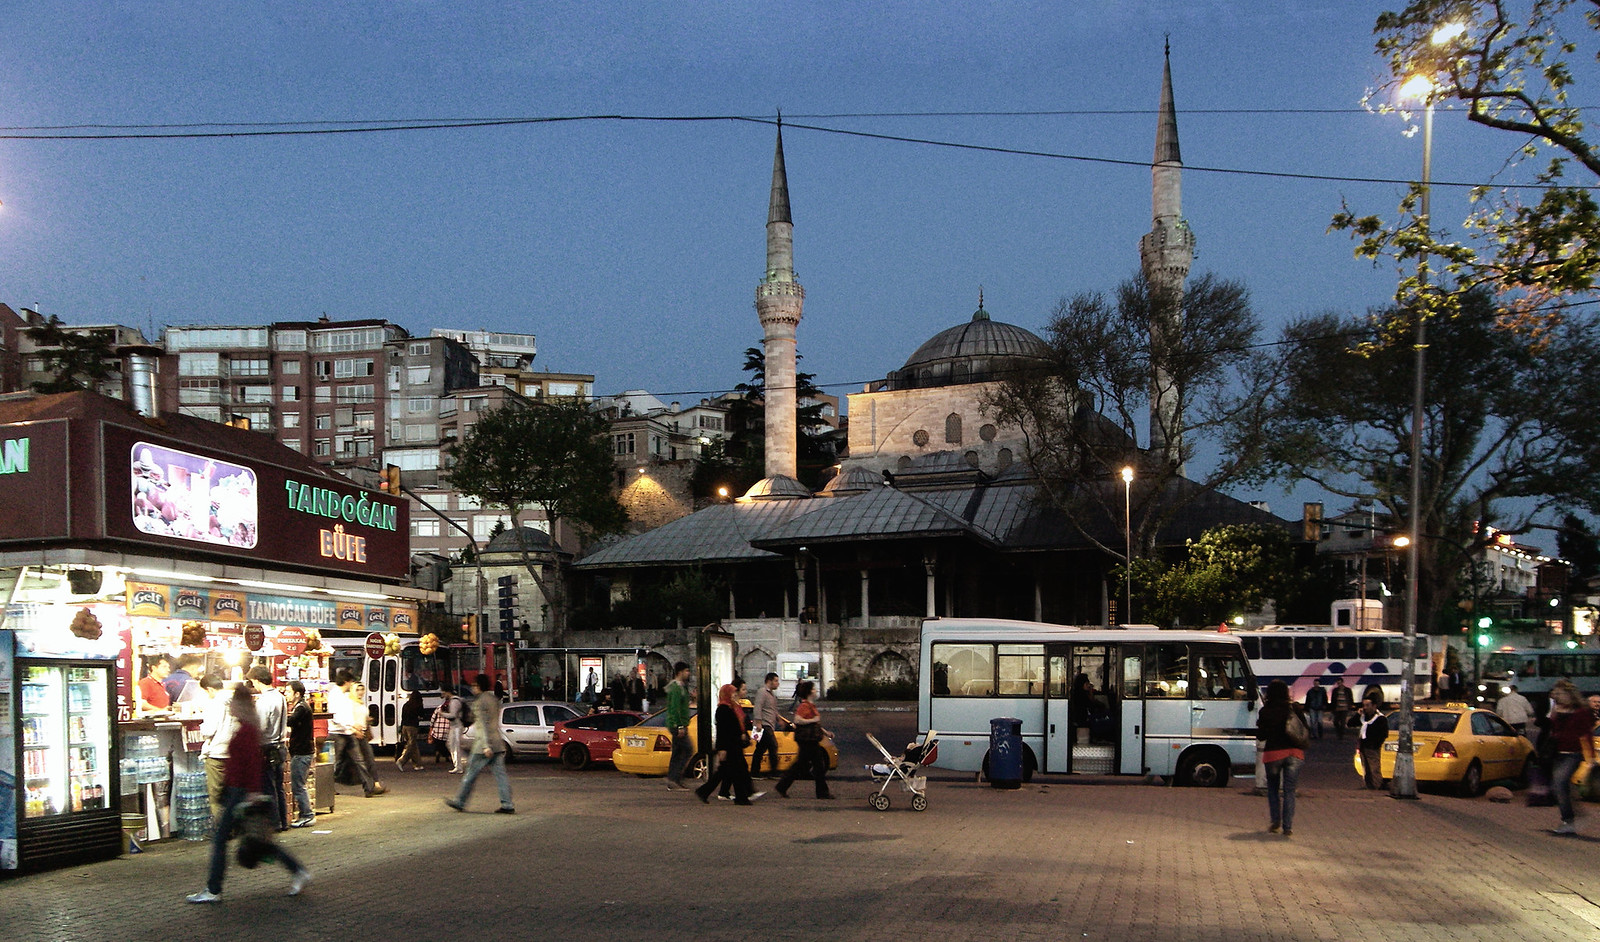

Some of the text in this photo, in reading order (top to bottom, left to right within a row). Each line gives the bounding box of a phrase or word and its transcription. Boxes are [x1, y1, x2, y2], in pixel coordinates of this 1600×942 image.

[285, 480, 397, 531] TANDOĞAN
[320, 523, 367, 563] BÜFE
[248, 600, 336, 625] TANDOĞAN BÜFE
